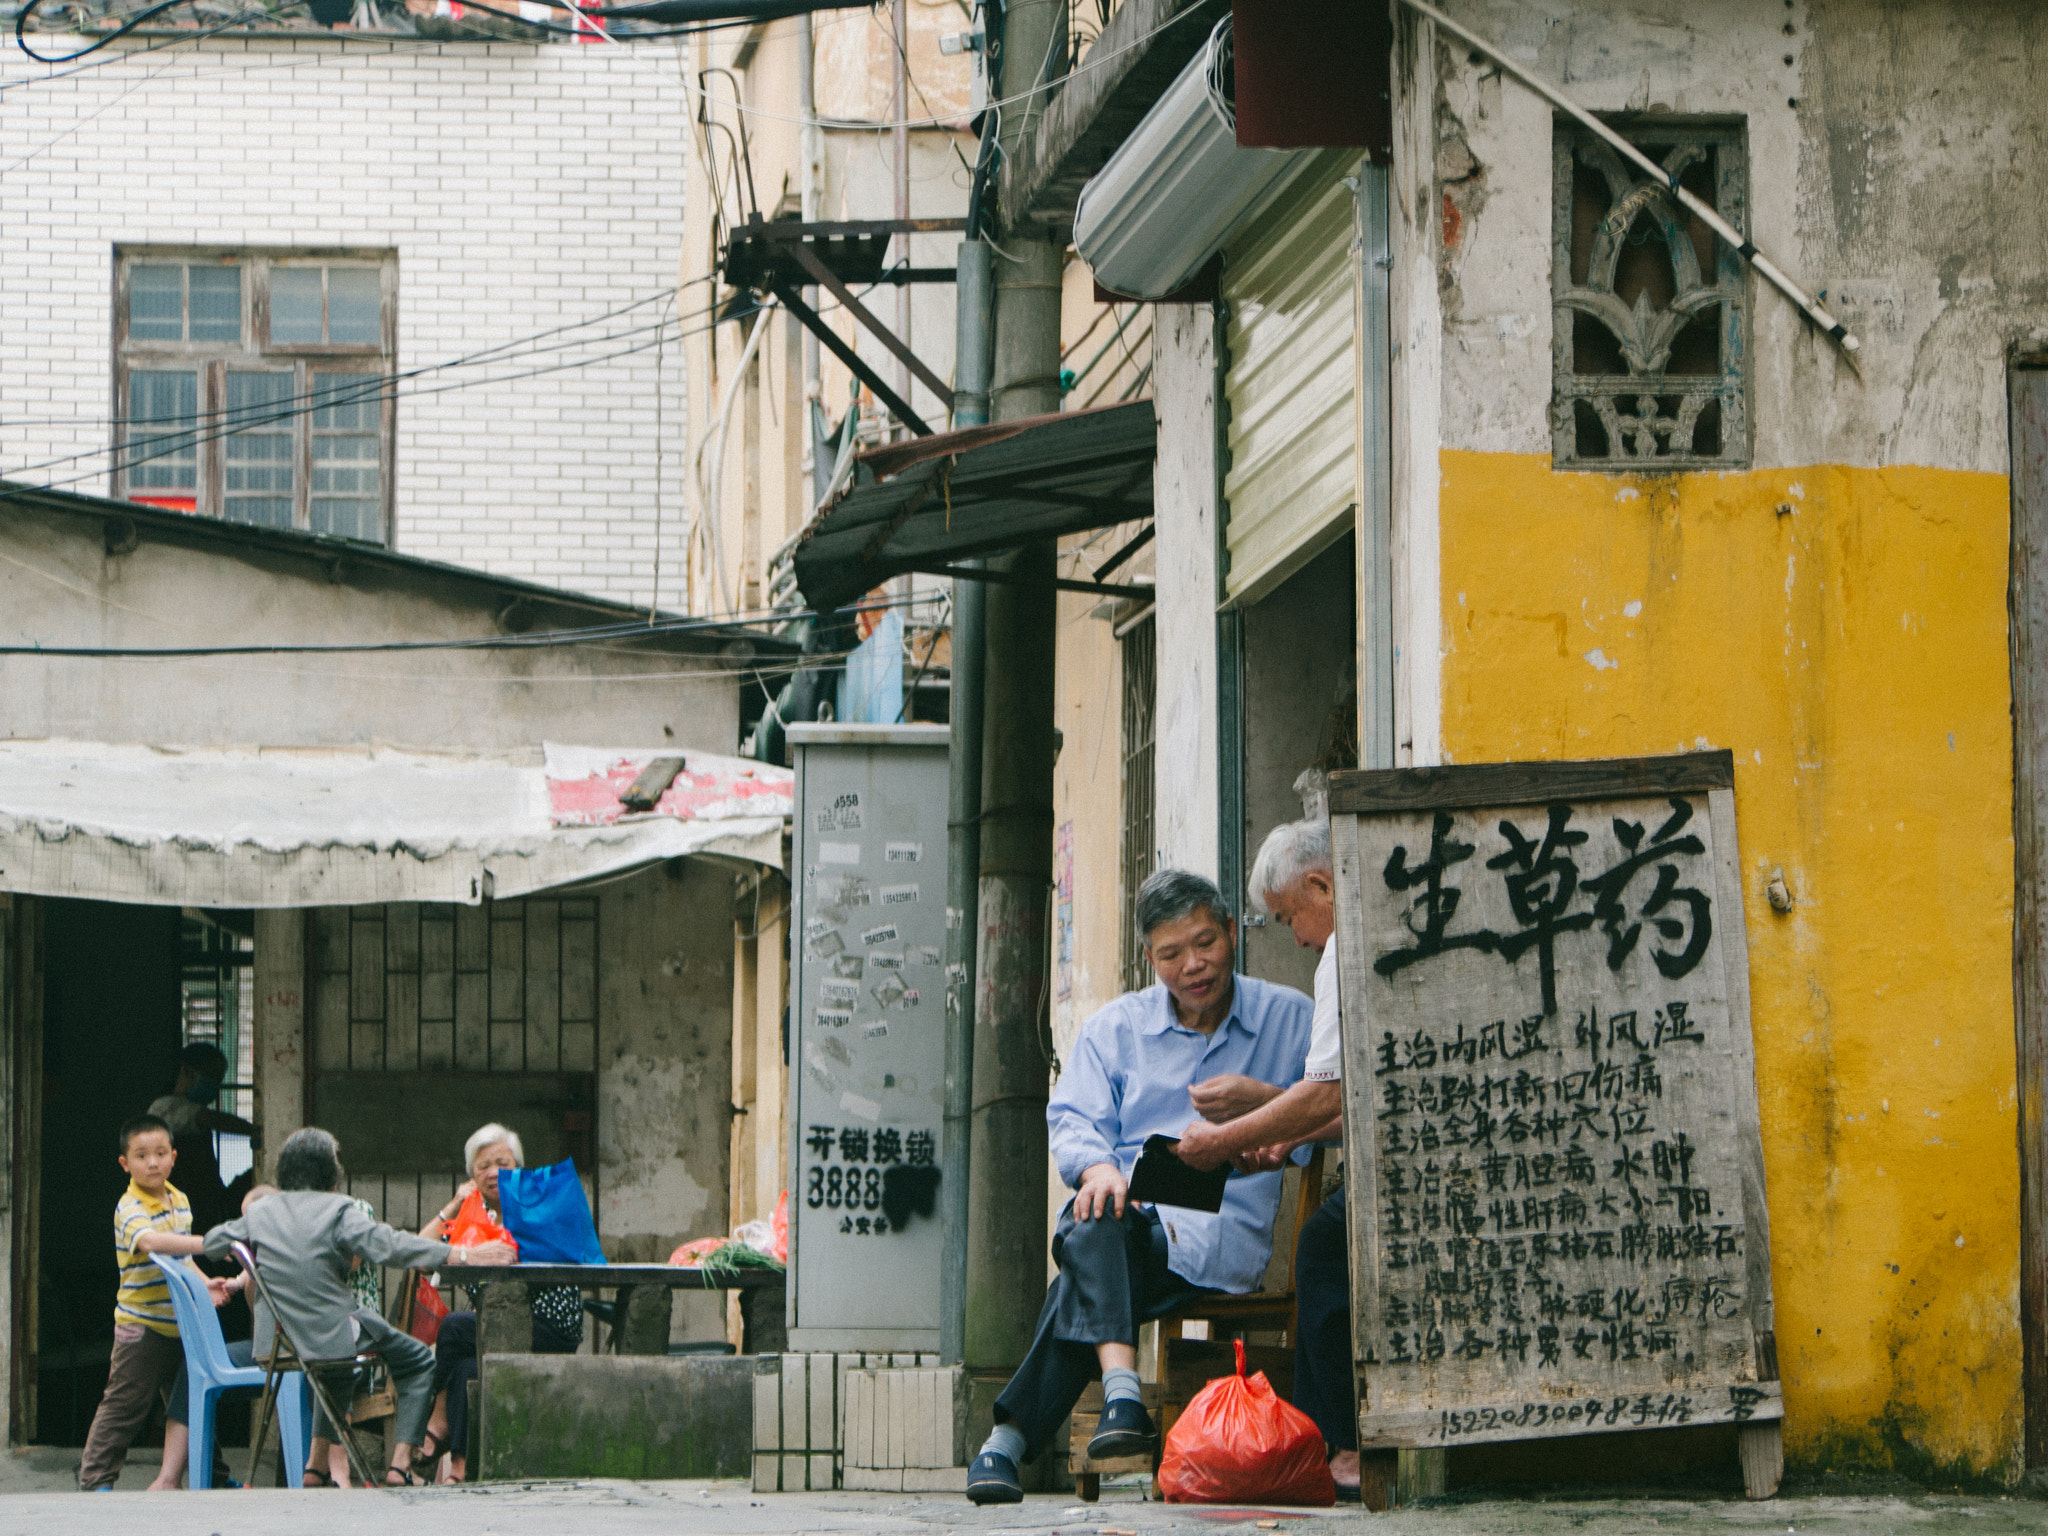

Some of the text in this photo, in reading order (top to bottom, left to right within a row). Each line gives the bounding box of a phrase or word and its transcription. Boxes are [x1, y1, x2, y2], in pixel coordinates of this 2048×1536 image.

[1374, 800, 1711, 1015] 生草药
[806, 1125, 936, 1165] 开锁换锁
[1383, 1103, 1656, 1155] 主治全身各种穴位
